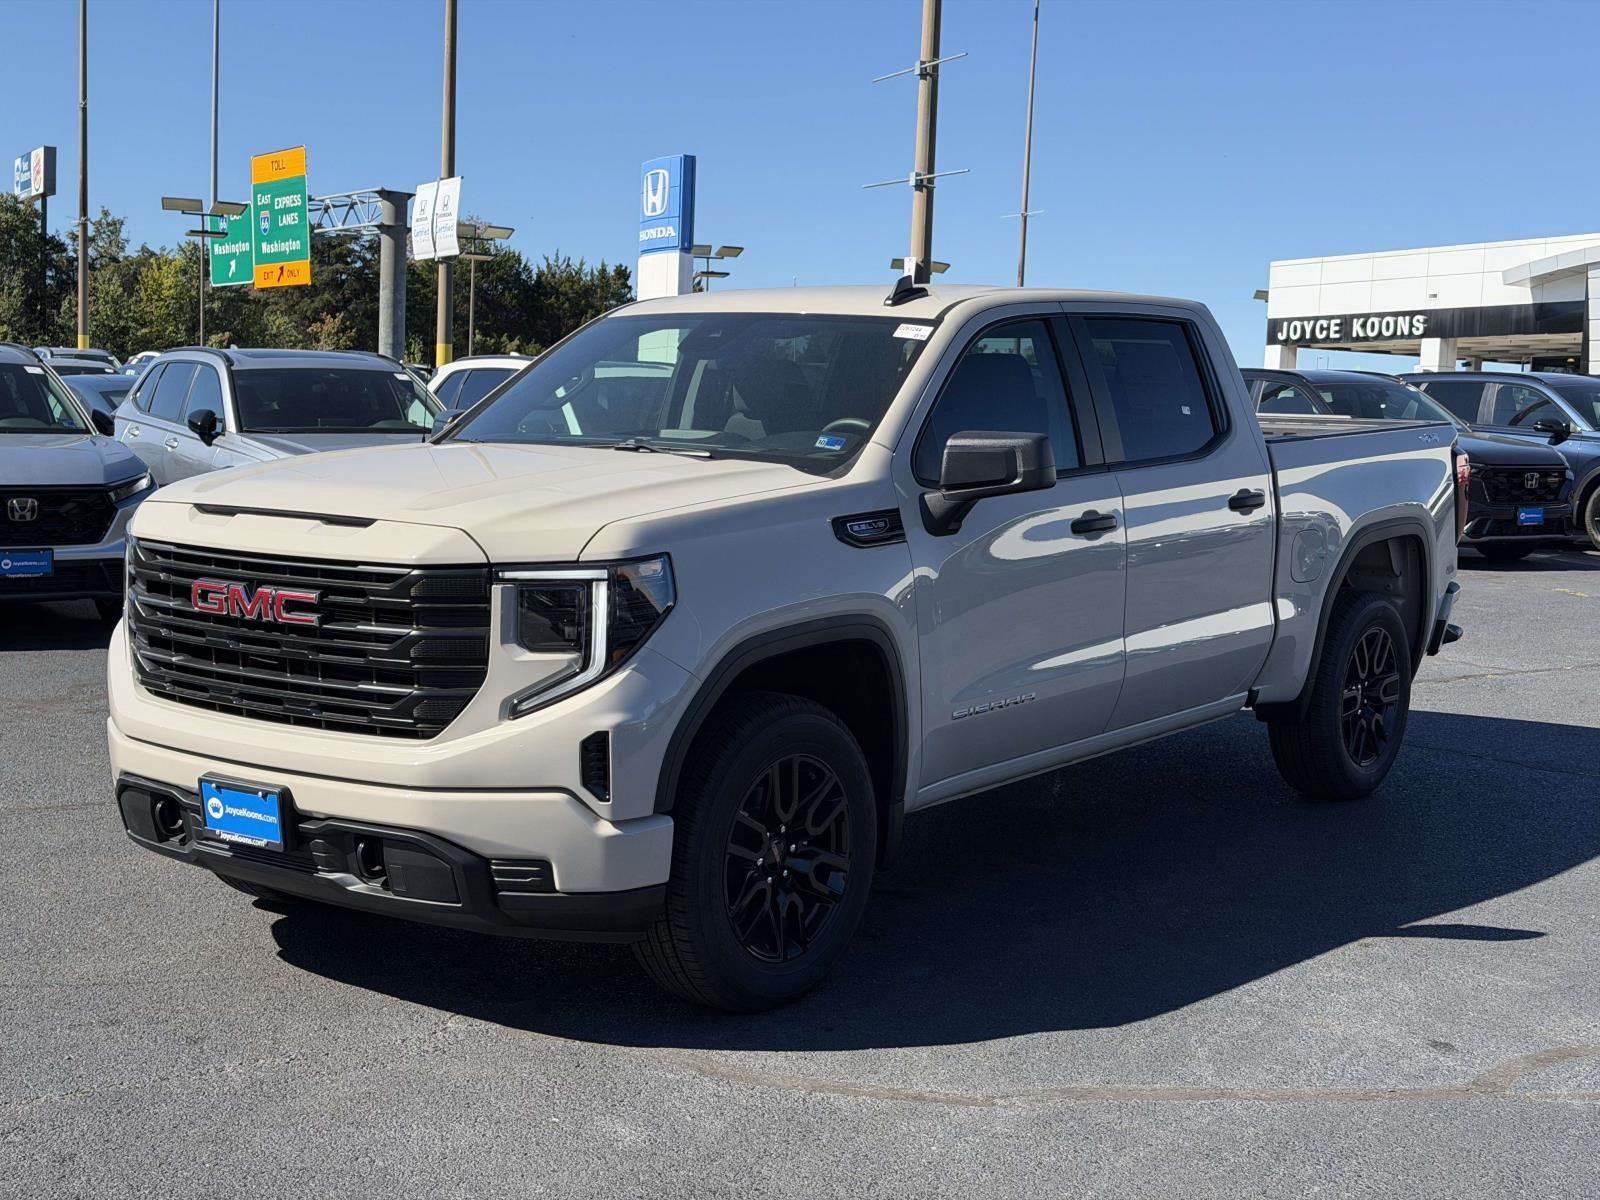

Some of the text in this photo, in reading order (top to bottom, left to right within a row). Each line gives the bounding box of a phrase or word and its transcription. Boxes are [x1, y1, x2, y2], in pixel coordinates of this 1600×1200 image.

[271, 159, 286, 172] TOLL
[257, 193, 271, 206] EAST
[274, 194, 302, 210] EXPRESS
[261, 218, 269, 229] 66
[278, 212, 299, 227] LANES
[639, 226, 677, 241] HONDA
[213, 241, 250, 256] Washington
[261, 238, 301, 255] Washington
[263, 269, 300, 280] EXIT ONLY
[1277, 315, 1426, 341] JOYCE KOONS
[191, 578, 321, 627] GMC
[952, 692, 1036, 720] SIERRA
[225, 804, 277, 824] JoyceKoons.com
